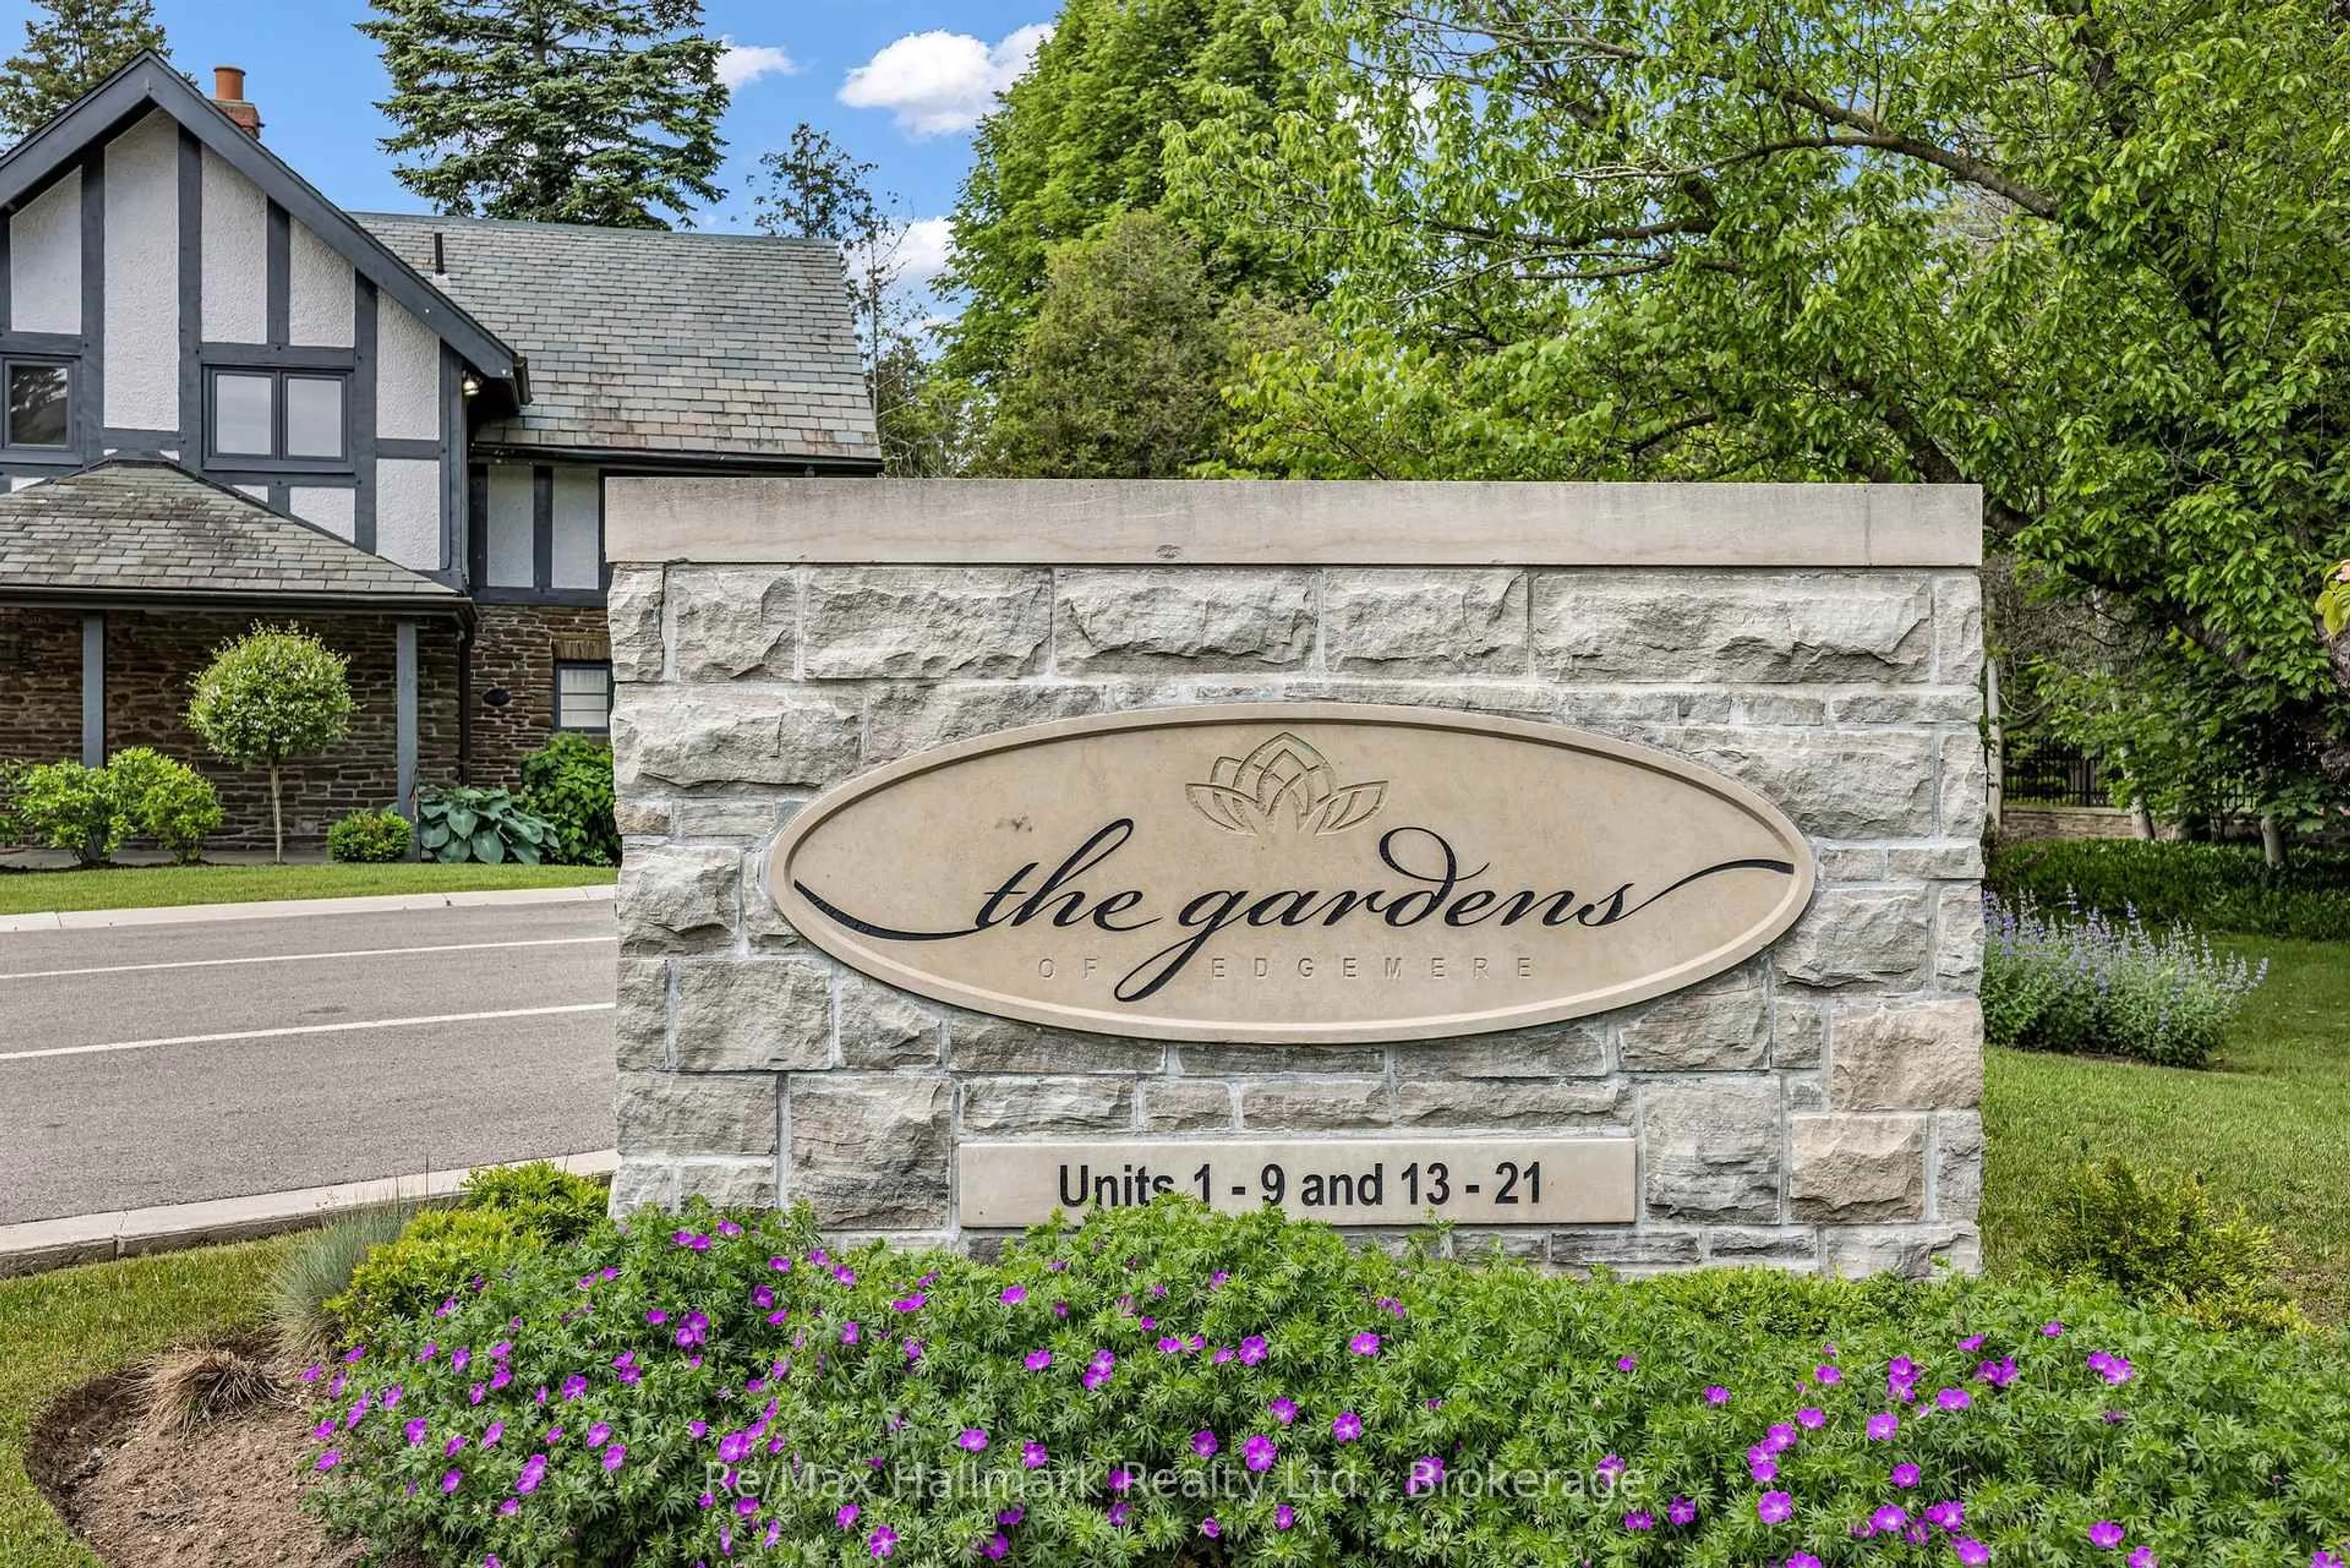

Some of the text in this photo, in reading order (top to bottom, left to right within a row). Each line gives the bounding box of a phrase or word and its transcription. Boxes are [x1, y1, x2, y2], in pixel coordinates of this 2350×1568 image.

[1114, 826, 1792, 1002] gardens
[1038, 957, 1532, 979] OF EDGEMERE
[1059, 1162, 1540, 1209] Units 1 - 9 and 13 - 21
